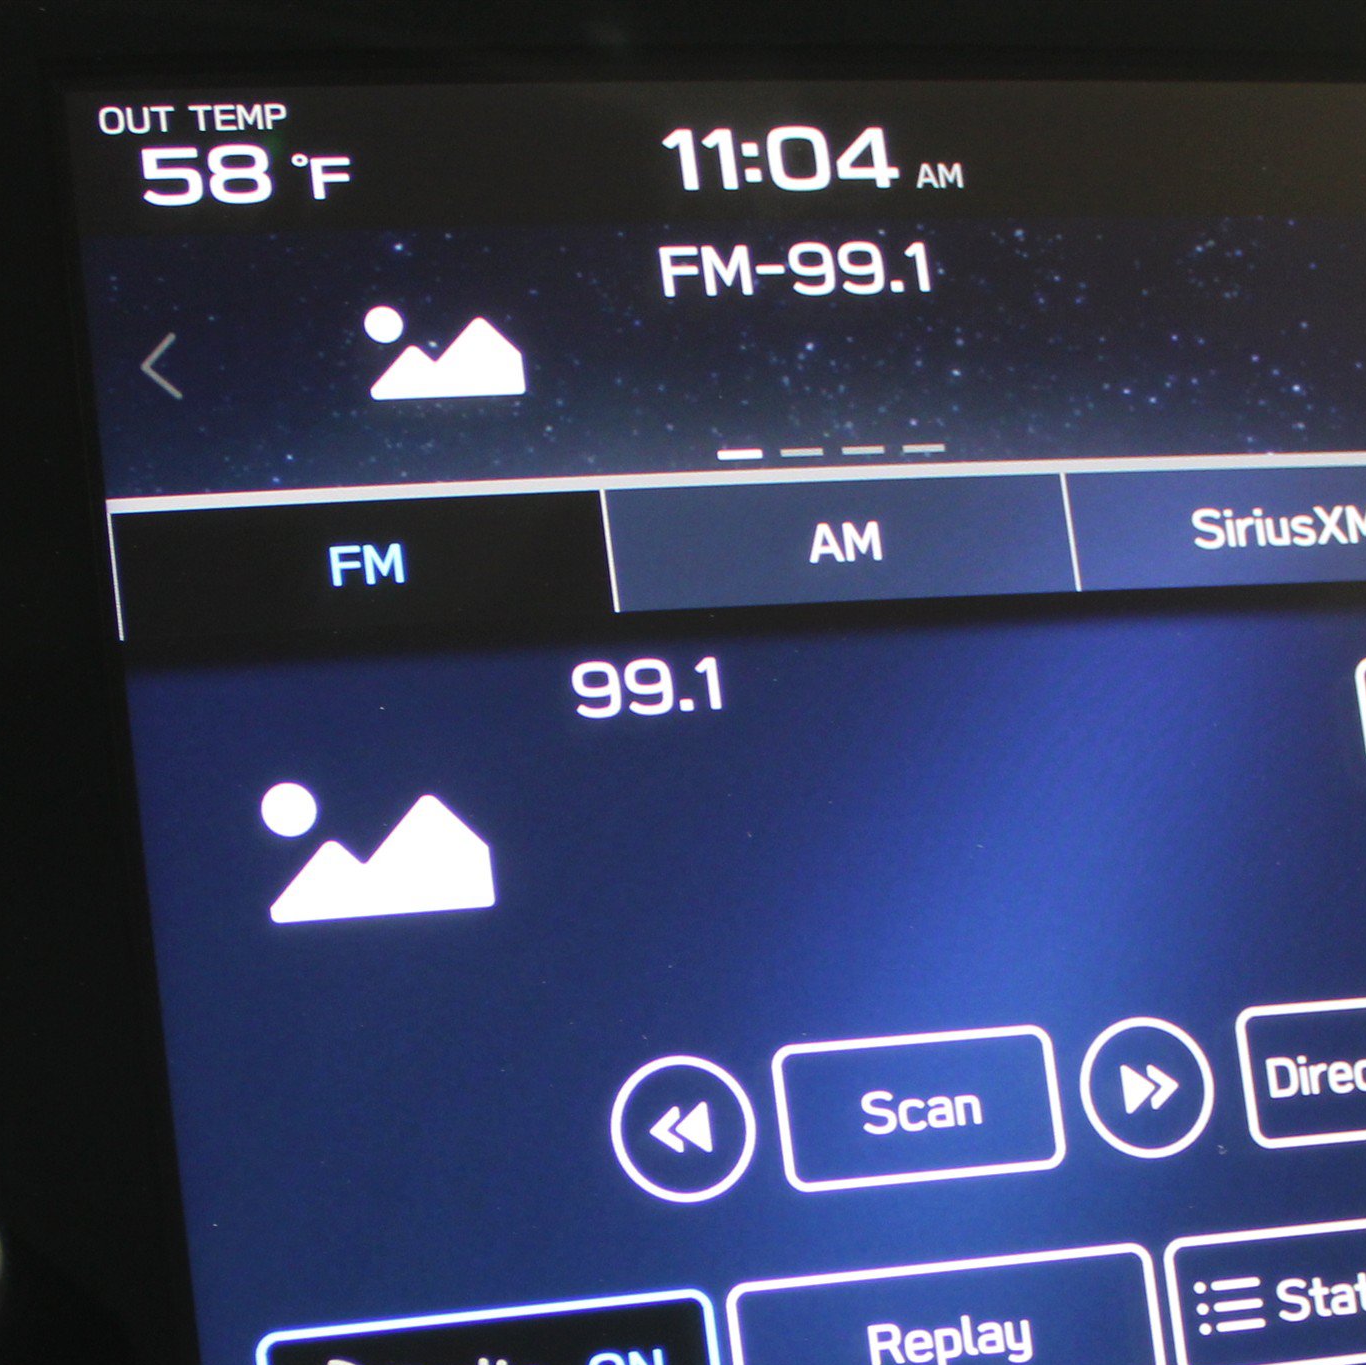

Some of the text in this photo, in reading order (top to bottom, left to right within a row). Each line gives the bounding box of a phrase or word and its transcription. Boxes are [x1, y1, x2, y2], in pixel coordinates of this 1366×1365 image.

[98, 103, 287, 135] OUT TEMP
[141, 144, 273, 207] 58
[661, 126, 965, 193] 11:04 AM
[658, 241, 934, 297] FM-99.1
[328, 542, 406, 587] FM
[809, 521, 884, 565] AM
[571, 656, 724, 719] 99.1
[860, 1091, 983, 1137] Scan
